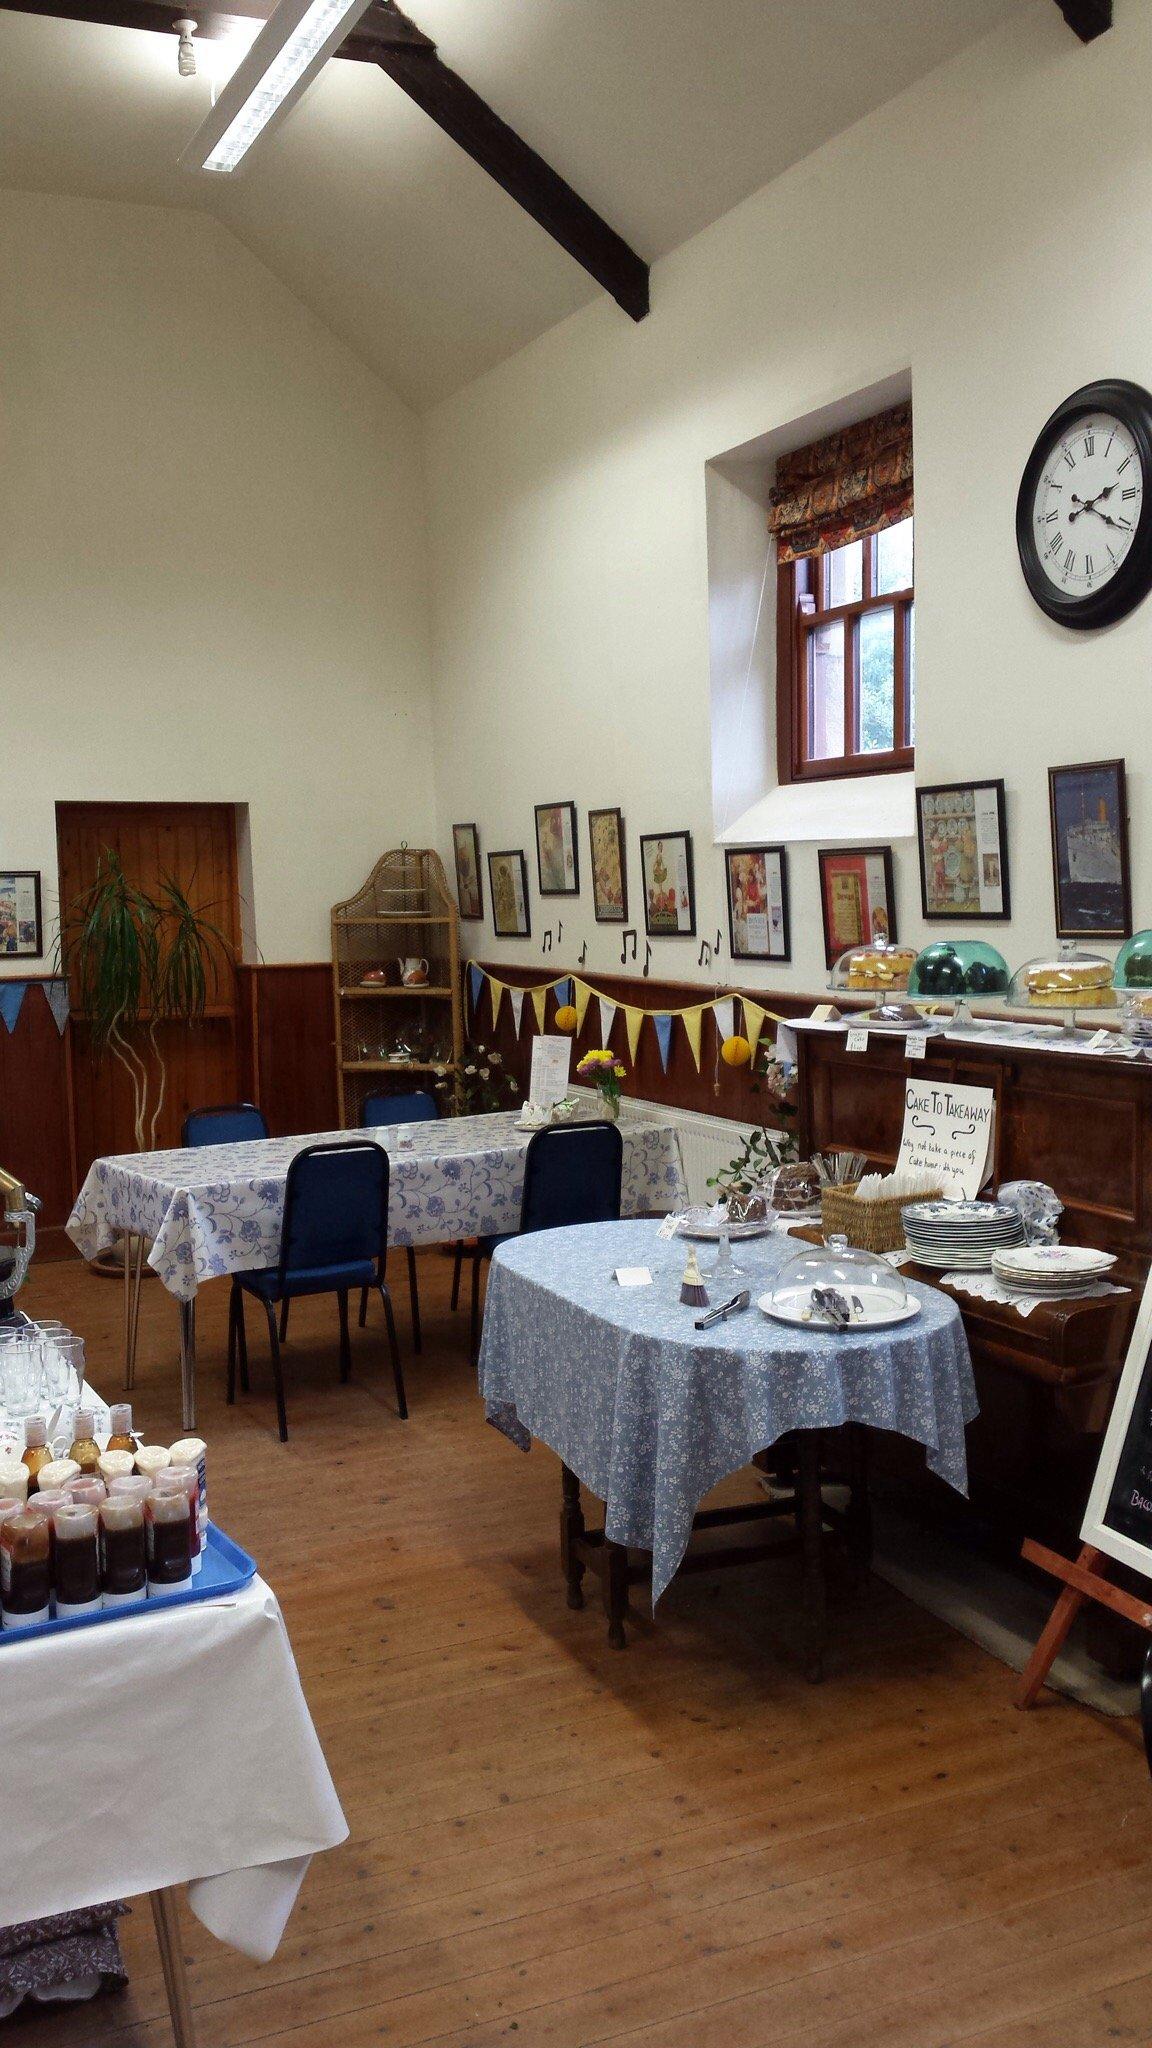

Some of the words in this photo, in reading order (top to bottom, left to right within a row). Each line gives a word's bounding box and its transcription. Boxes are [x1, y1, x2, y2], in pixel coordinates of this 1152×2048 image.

[906, 1089, 930, 1113] CAKE
[930, 1091, 943, 1115] TO
[944, 1093, 990, 1122] TAKEAWAY
[917, 1140, 927, 1151] not
[928, 1143, 942, 1154] take
[950, 1150, 967, 1160] piece
[967, 1149, 977, 1166] of
[951, 1166, 965, 1179] you
